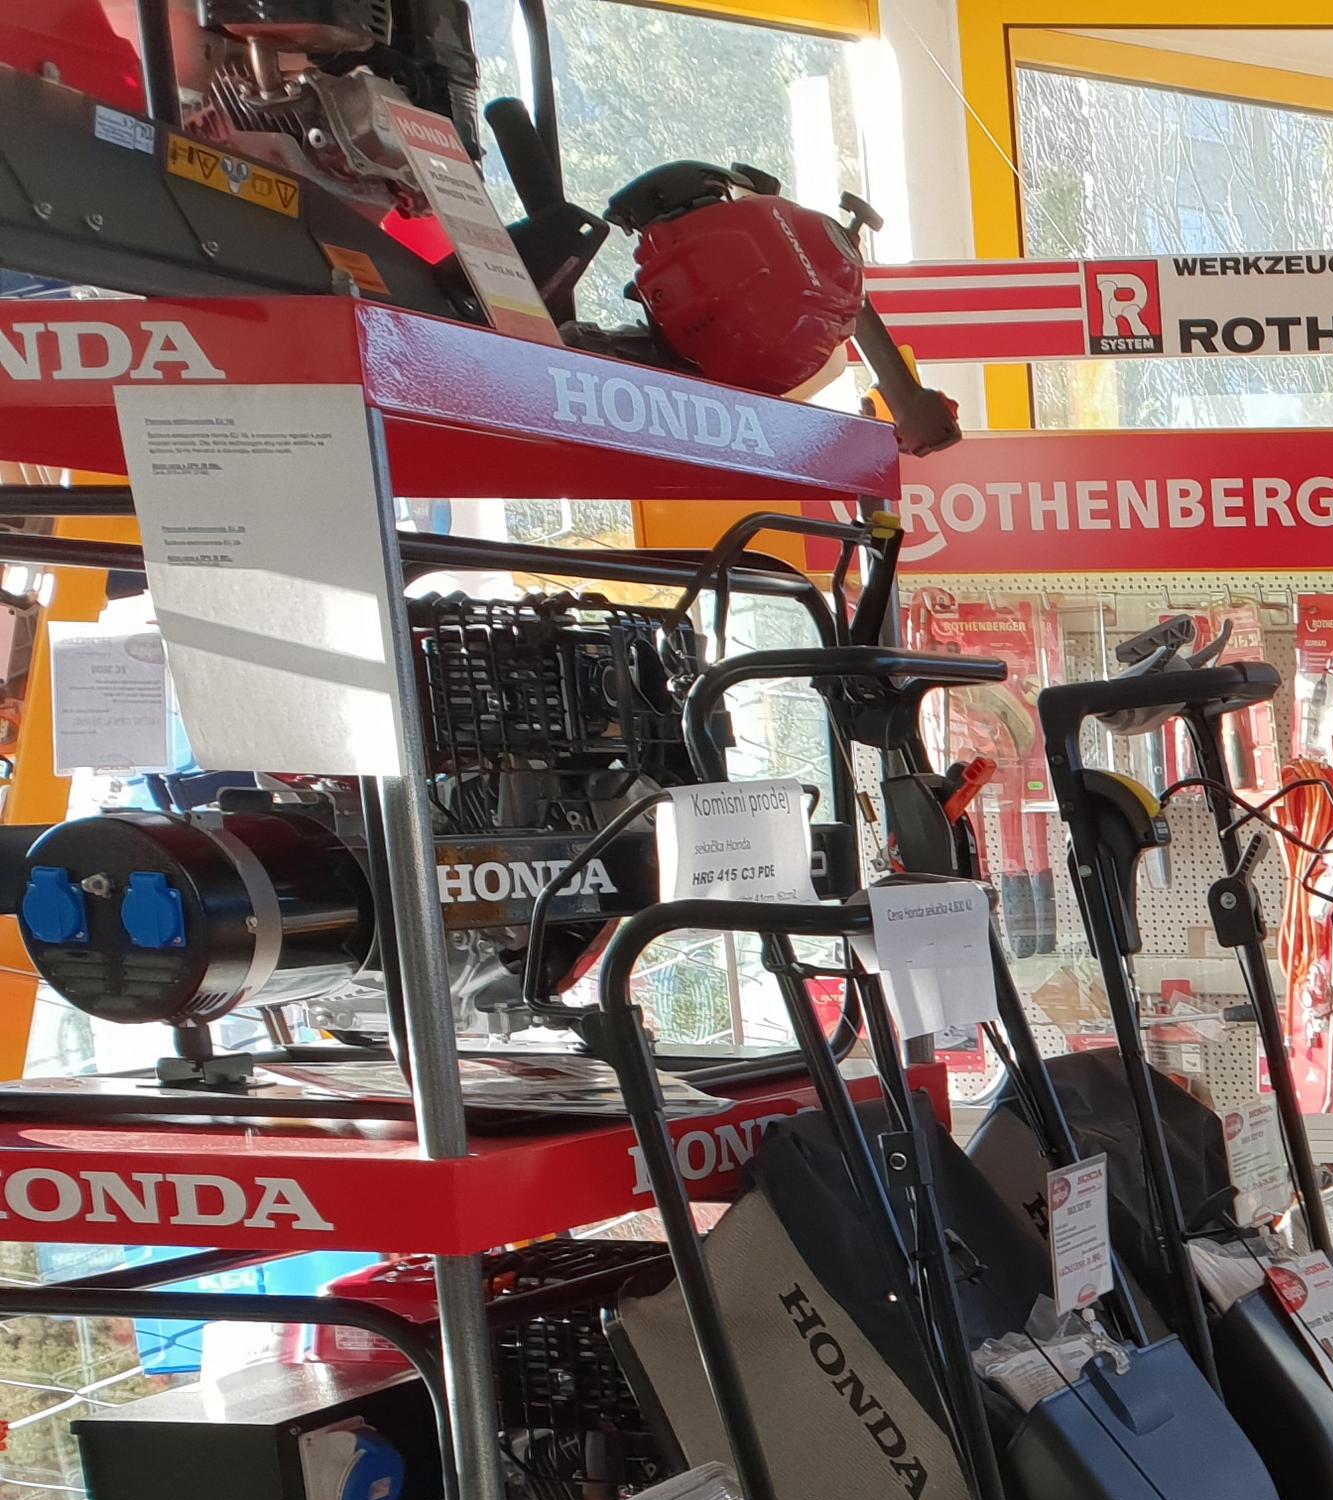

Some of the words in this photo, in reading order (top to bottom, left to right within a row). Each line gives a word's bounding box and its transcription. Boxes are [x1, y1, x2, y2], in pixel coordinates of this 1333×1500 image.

[397, 117, 463, 154] HONDA
[772, 206, 823, 288] HONDA
[0, 320, 226, 381] NDA
[1099, 338, 1156, 351] SYSTEM
[552, 367, 777, 457] HONDA
[751, 786, 791, 818] prodej
[726, 839, 751, 851] Honda
[437, 858, 619, 904] HONDA
[693, 870, 714, 886] HRG
[717, 868, 737, 882] 415
[742, 866, 755, 881] C3
[758, 864, 776, 878] PDE
[0, 1167, 335, 1232] ONDA
